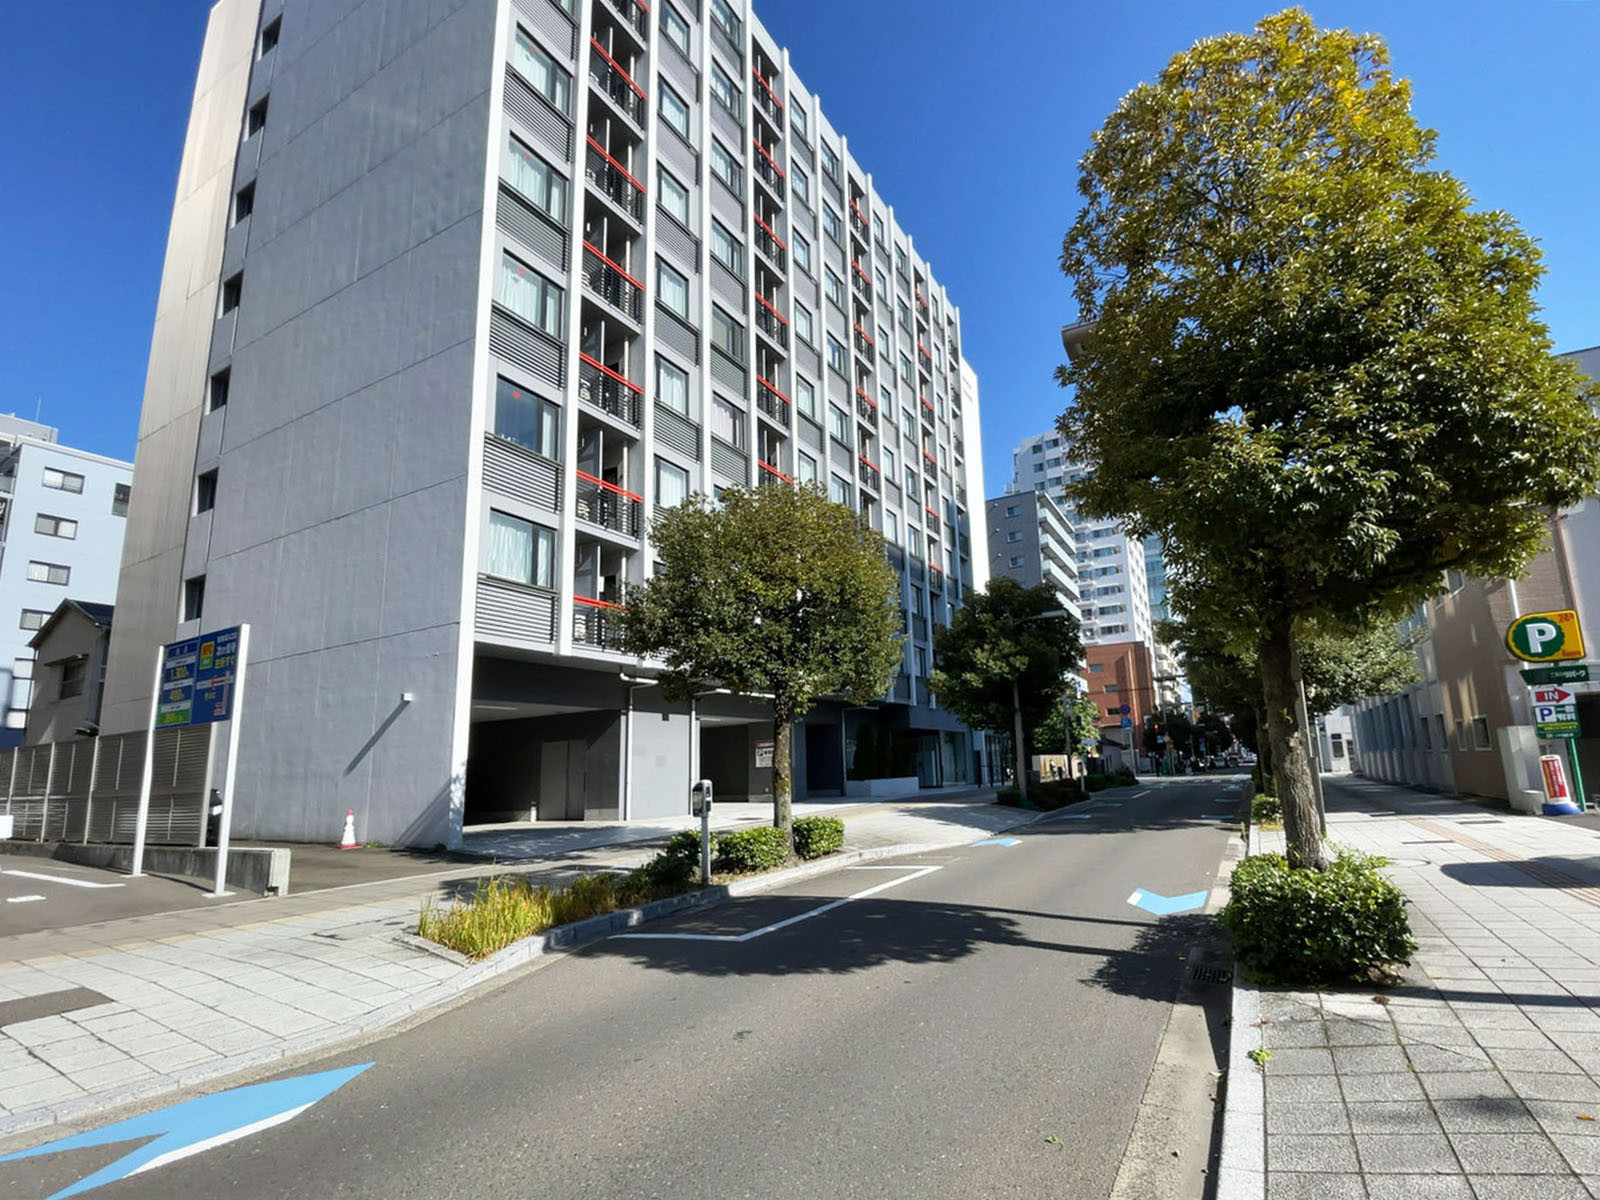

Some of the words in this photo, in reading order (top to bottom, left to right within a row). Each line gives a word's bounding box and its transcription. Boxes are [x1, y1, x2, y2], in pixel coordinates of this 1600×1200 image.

[1525, 623, 1557, 654] P
[1544, 691, 1559, 701] IN
[1540, 708, 1553, 722] P
